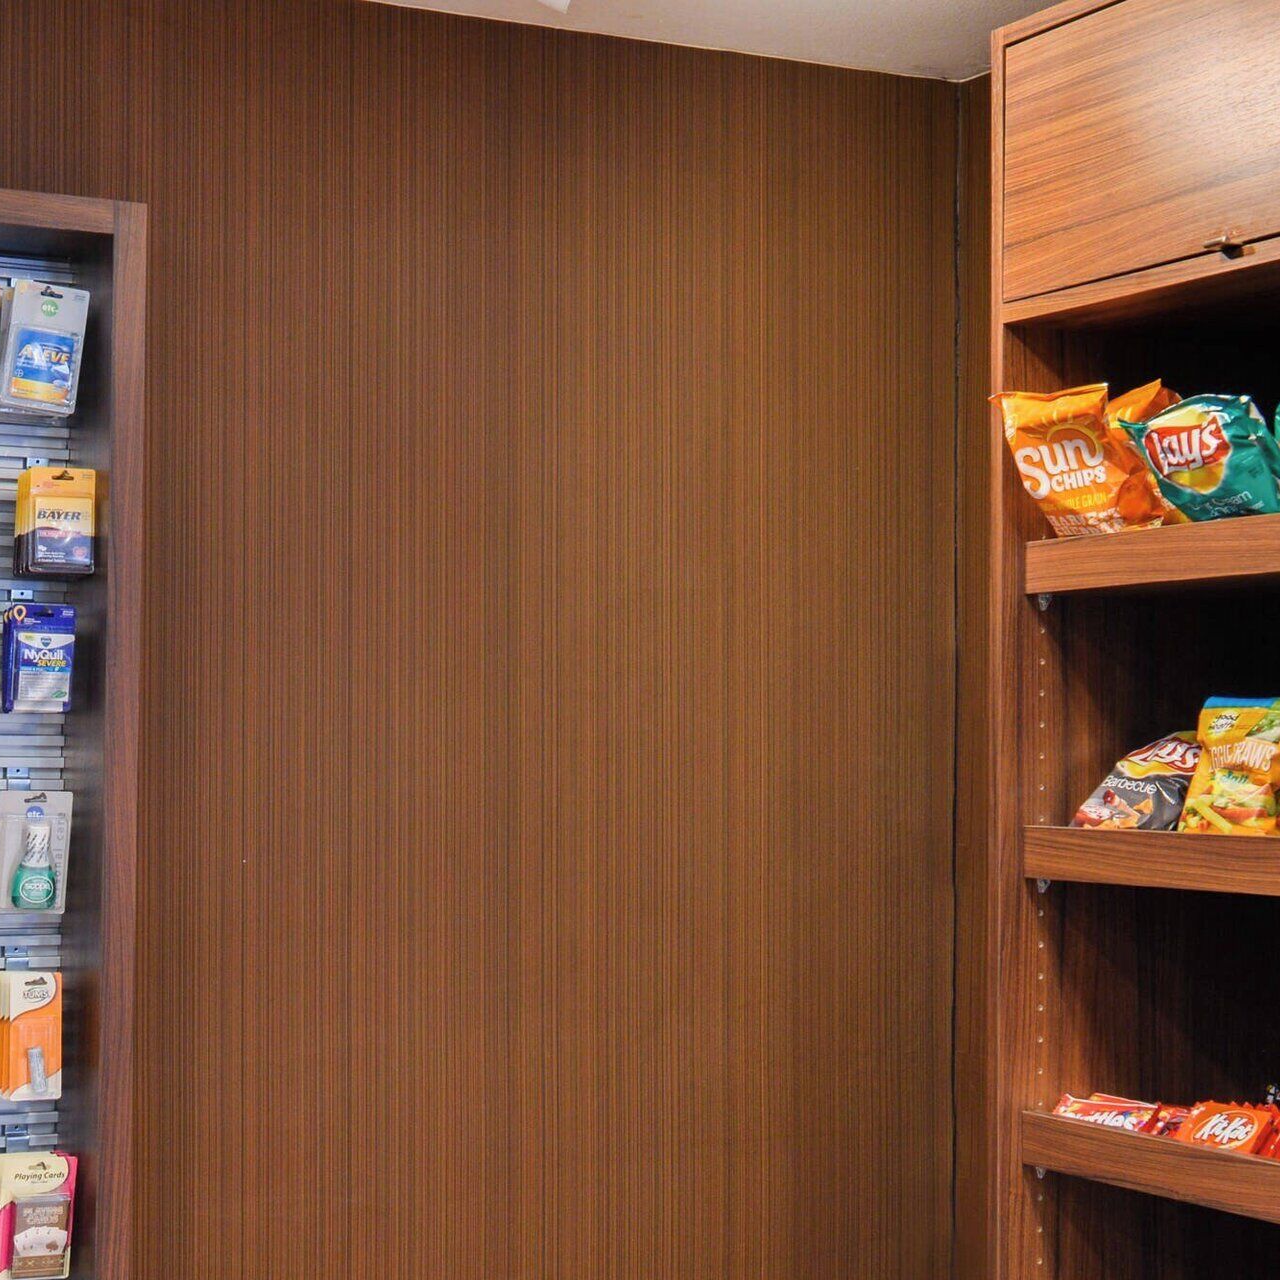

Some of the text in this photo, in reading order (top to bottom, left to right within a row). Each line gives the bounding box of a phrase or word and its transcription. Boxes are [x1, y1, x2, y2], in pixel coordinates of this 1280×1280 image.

[1017, 436, 1105, 500] Sun
[1051, 464, 1107, 490] CHIPS
[36, 510, 81, 520] BAYER
[23, 649, 62, 662] NyQuil
[37, 659, 66, 667] SEVERE
[1103, 775, 1158, 794] Barbecue
[14, 1171, 65, 1181] Playing Cards
